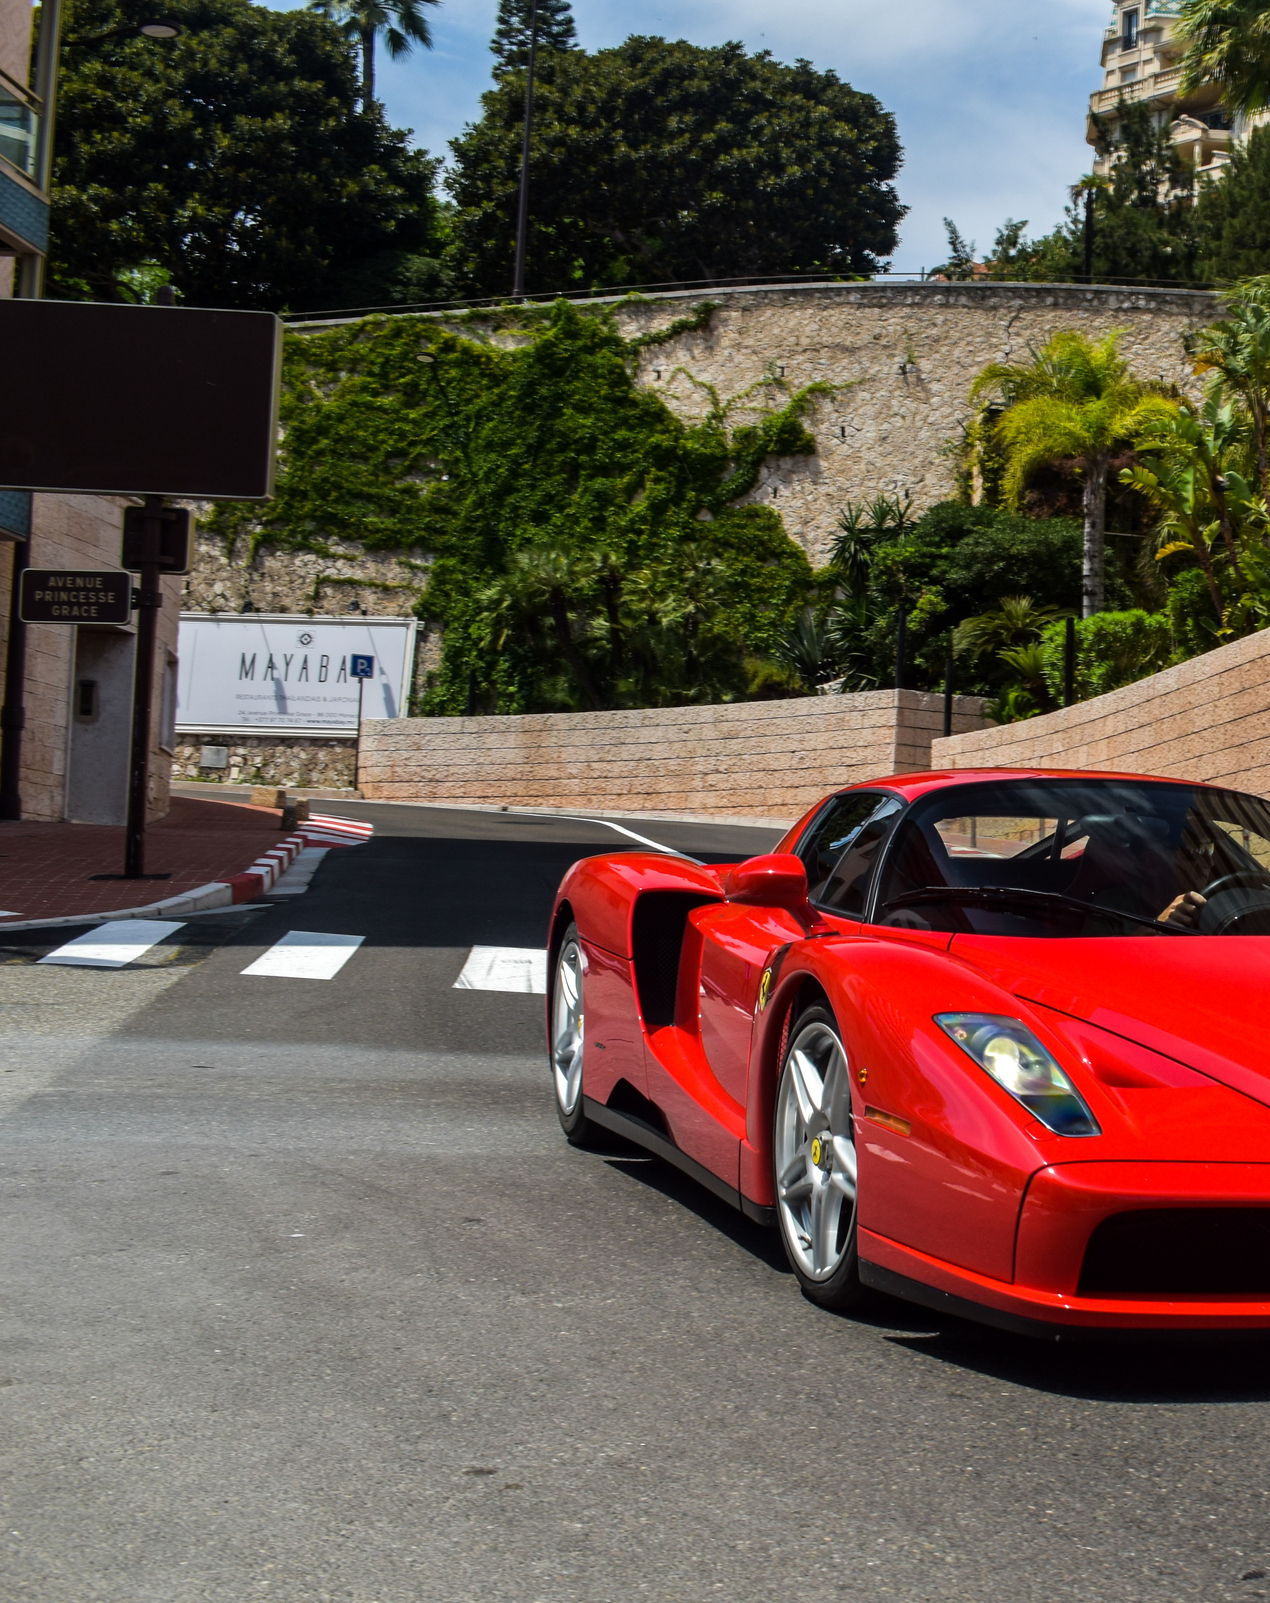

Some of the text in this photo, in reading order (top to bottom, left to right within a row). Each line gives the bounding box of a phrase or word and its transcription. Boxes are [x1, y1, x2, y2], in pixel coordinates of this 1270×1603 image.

[48, 576, 104, 588] AVENUE
[35, 590, 116, 603] PRINCESSE
[51, 605, 99, 617] GRACE
[238, 652, 350, 683] MAYABA
[356, 658, 368, 673] P
